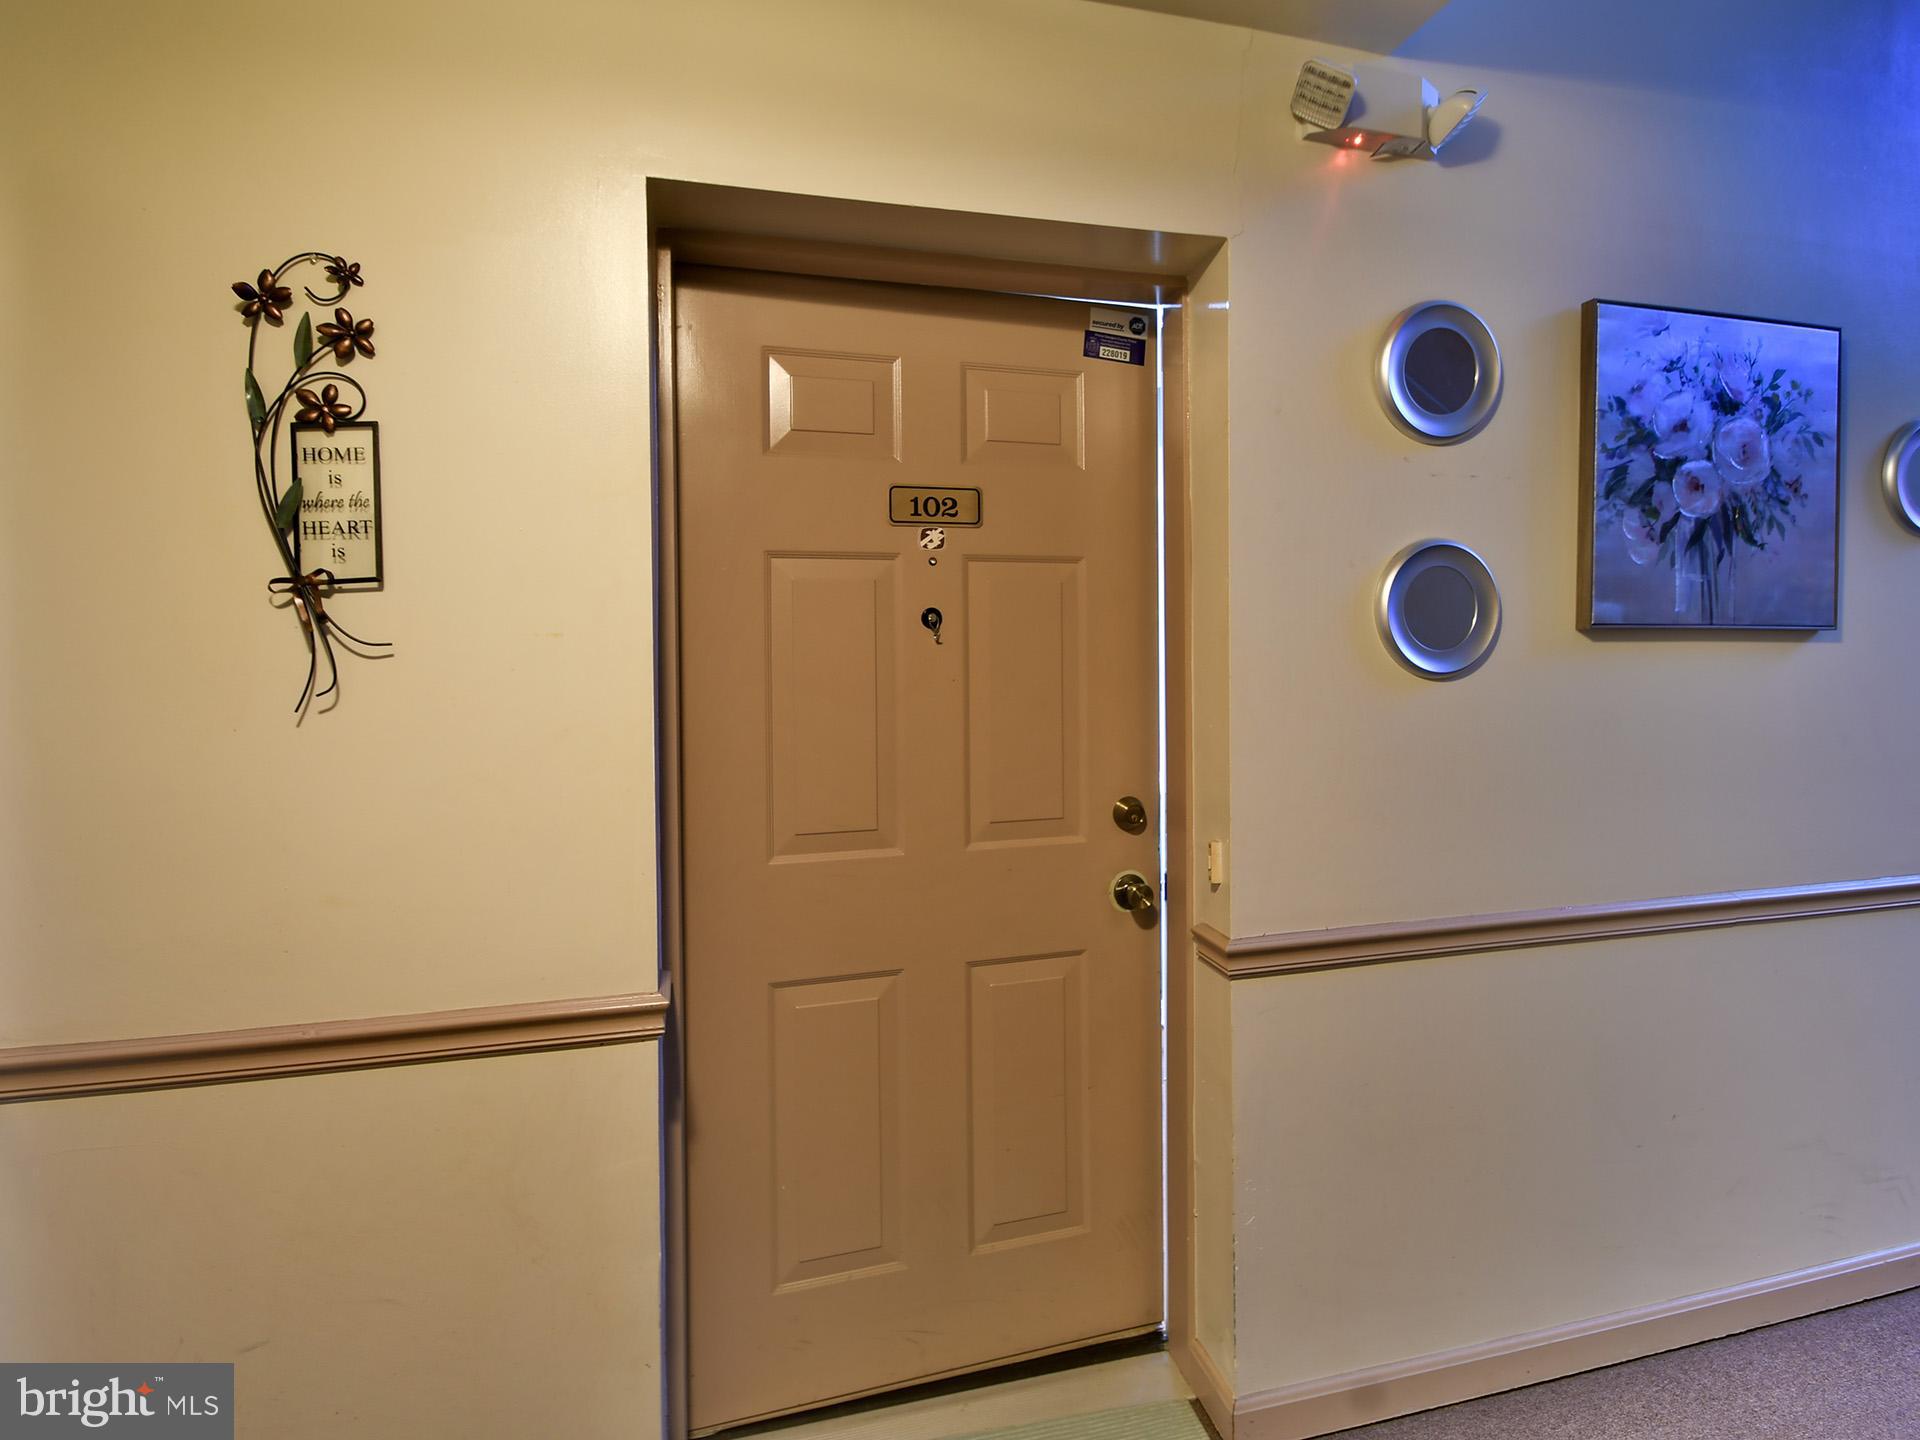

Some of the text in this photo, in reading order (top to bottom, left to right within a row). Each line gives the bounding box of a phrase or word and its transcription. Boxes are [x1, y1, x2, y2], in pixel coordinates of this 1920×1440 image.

[1102, 348, 1127, 359] 228019
[302, 447, 366, 462] HOME
[328, 469, 342, 485] is
[302, 491, 370, 509] where the
[910, 496, 959, 517] 102
[302, 520, 372, 536] HEART
[331, 543, 346, 558] is
